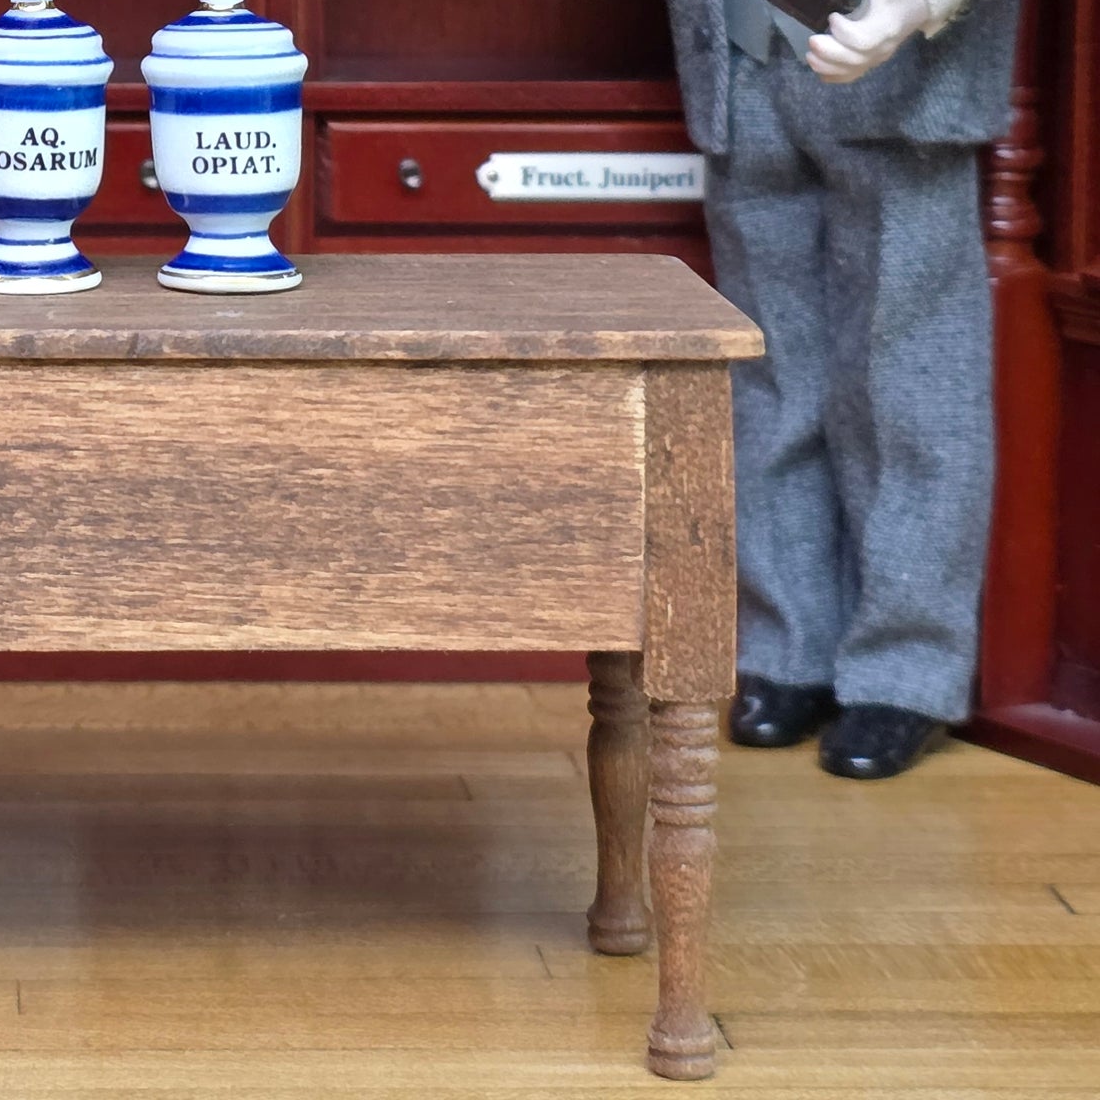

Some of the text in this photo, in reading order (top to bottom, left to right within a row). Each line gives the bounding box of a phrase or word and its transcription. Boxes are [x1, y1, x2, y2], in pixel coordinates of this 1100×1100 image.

[20, 127, 66, 147] AQ.
[195, 131, 277, 150] LAUD.
[191, 155, 280, 175] OPIAT.
[520, 165, 695, 191] Fruct. Juniperi
